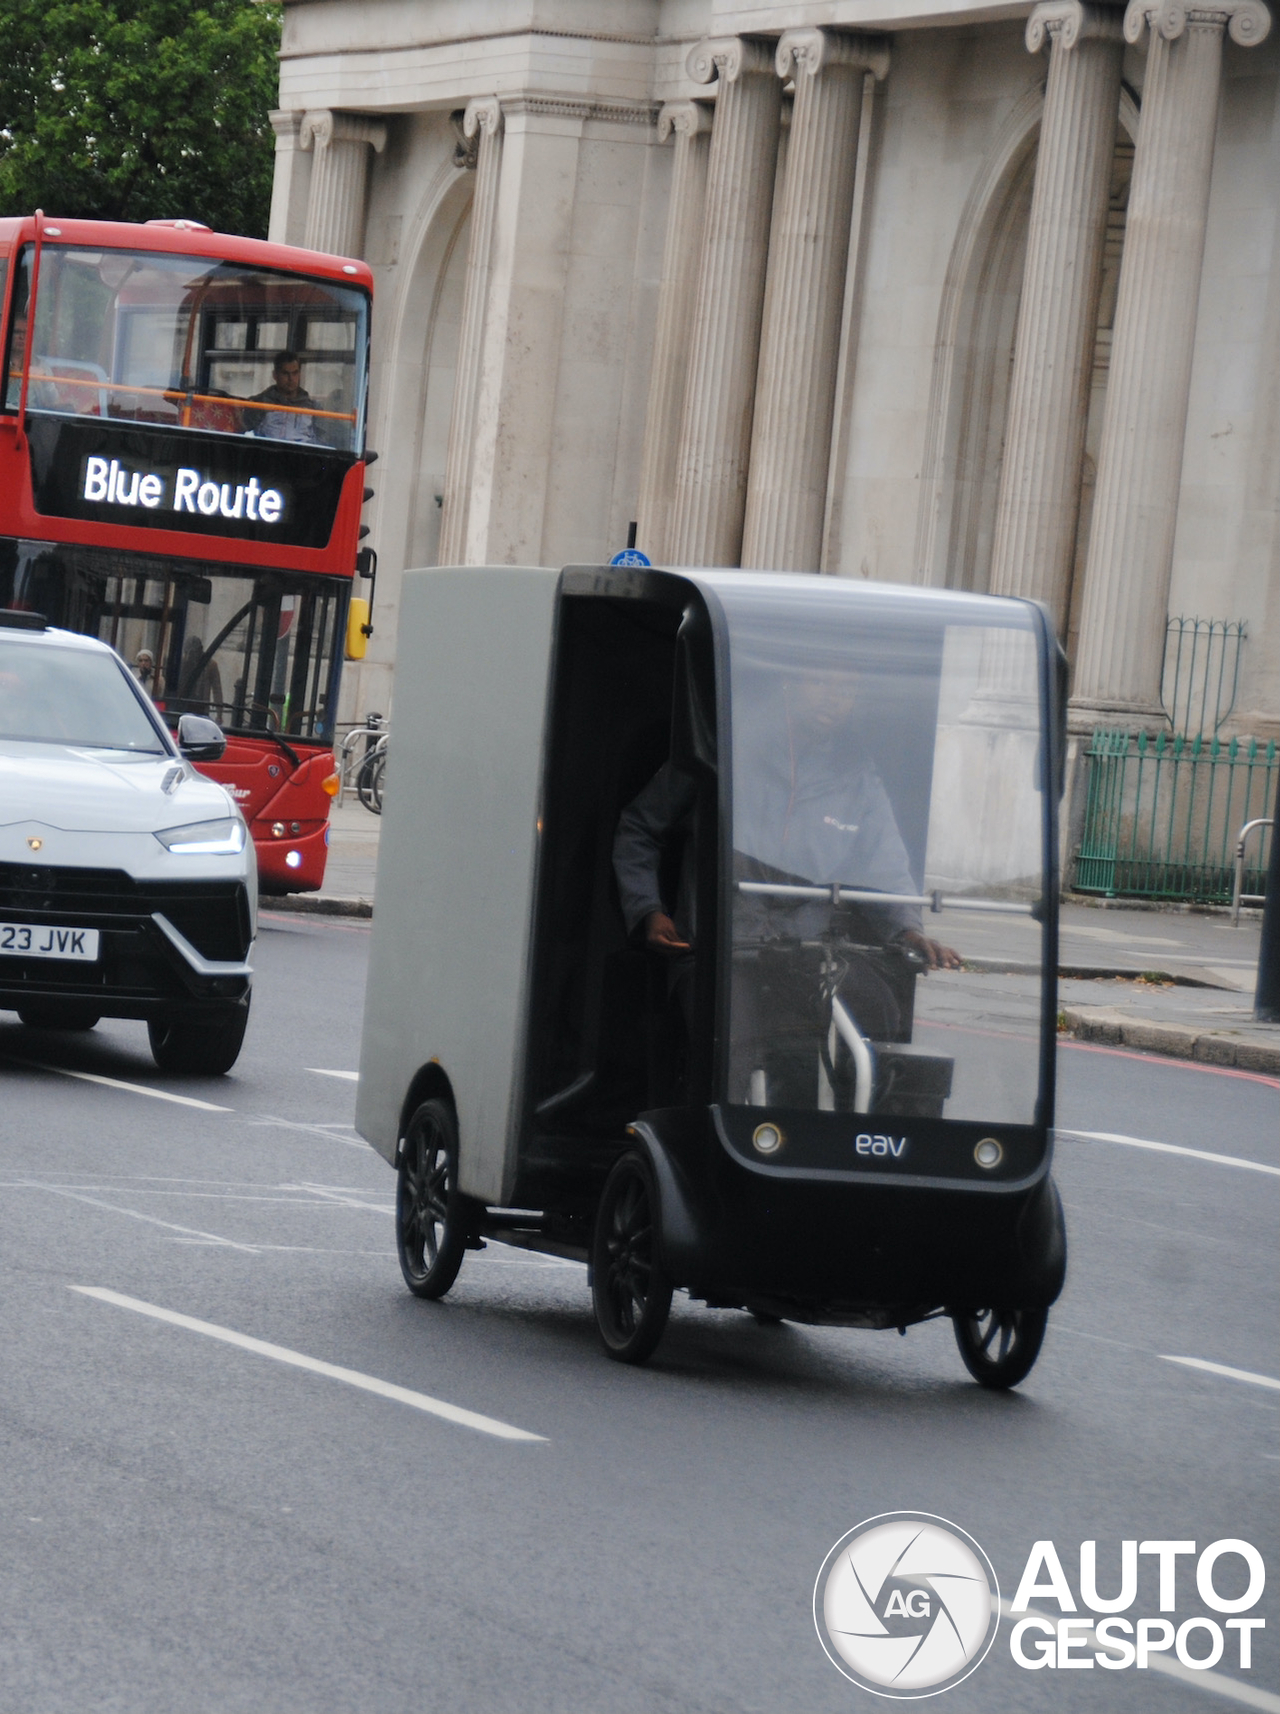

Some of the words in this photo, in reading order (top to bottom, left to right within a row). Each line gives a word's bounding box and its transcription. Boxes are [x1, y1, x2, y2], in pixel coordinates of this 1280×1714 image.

[84, 456, 163, 507] Blue
[173, 468, 282, 523] Route
[39, 930, 86, 954] JVK
[855, 1133, 907, 1157] eav
